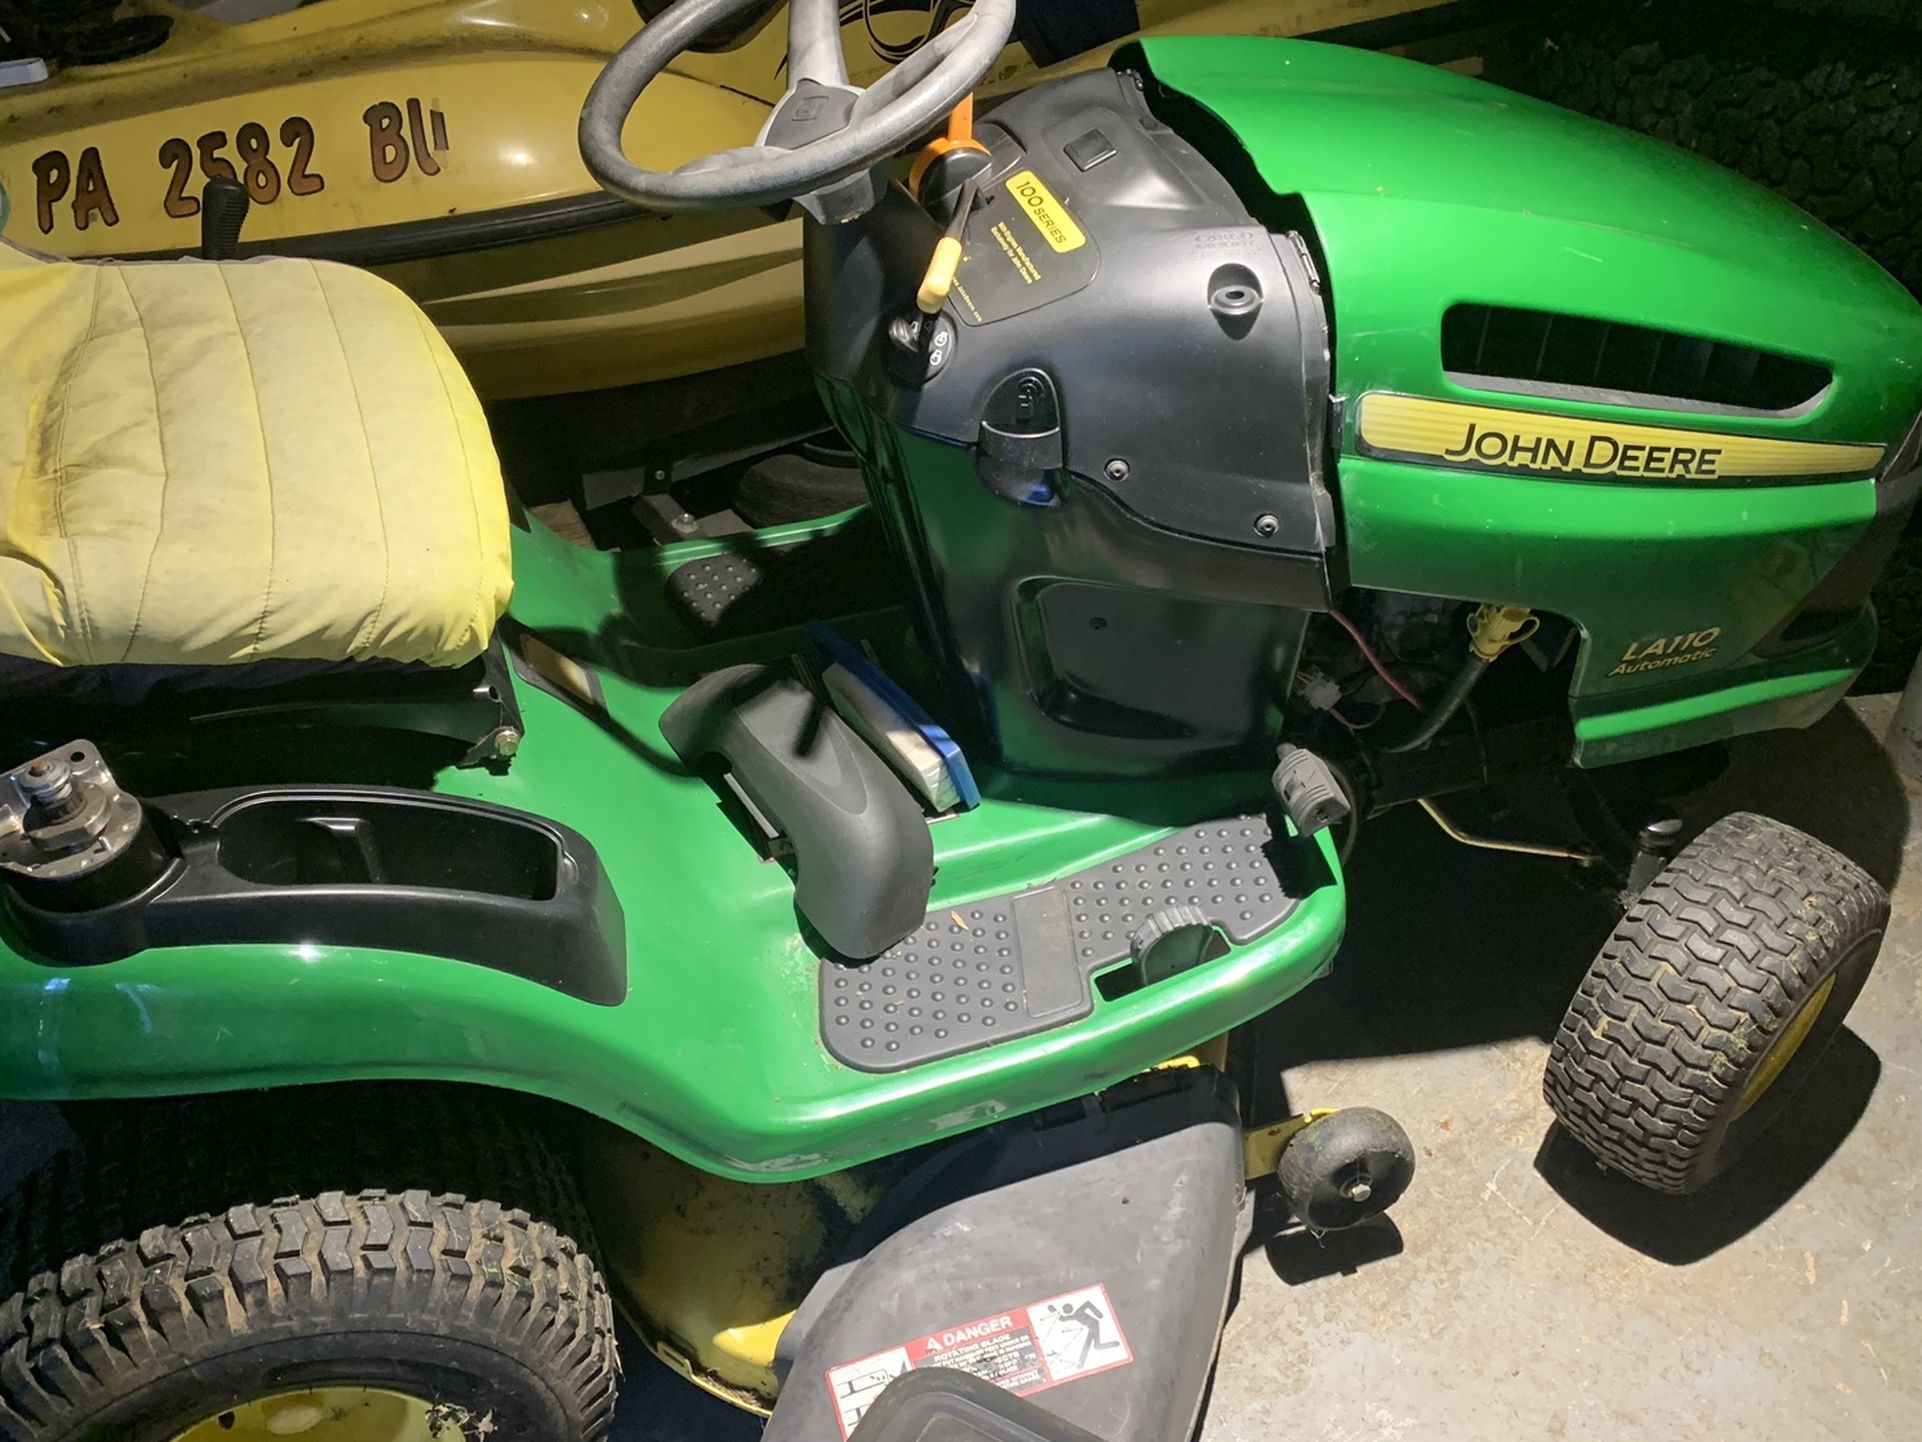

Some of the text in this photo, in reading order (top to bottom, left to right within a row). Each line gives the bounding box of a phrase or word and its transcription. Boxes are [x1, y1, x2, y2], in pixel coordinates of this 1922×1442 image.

[31, 147, 119, 234] PA
[159, 116, 324, 218] 2582
[1016, 181, 1066, 244] 100 SERIES
[1444, 422, 1724, 478] JOHN DEERE
[1622, 626, 1721, 661] LA110
[1608, 647, 1717, 677] Automatic
[933, 1342, 979, 1362] ROTATING
[979, 1332, 1011, 1347] BLADE
[942, 1316, 1013, 1347] DANGER
